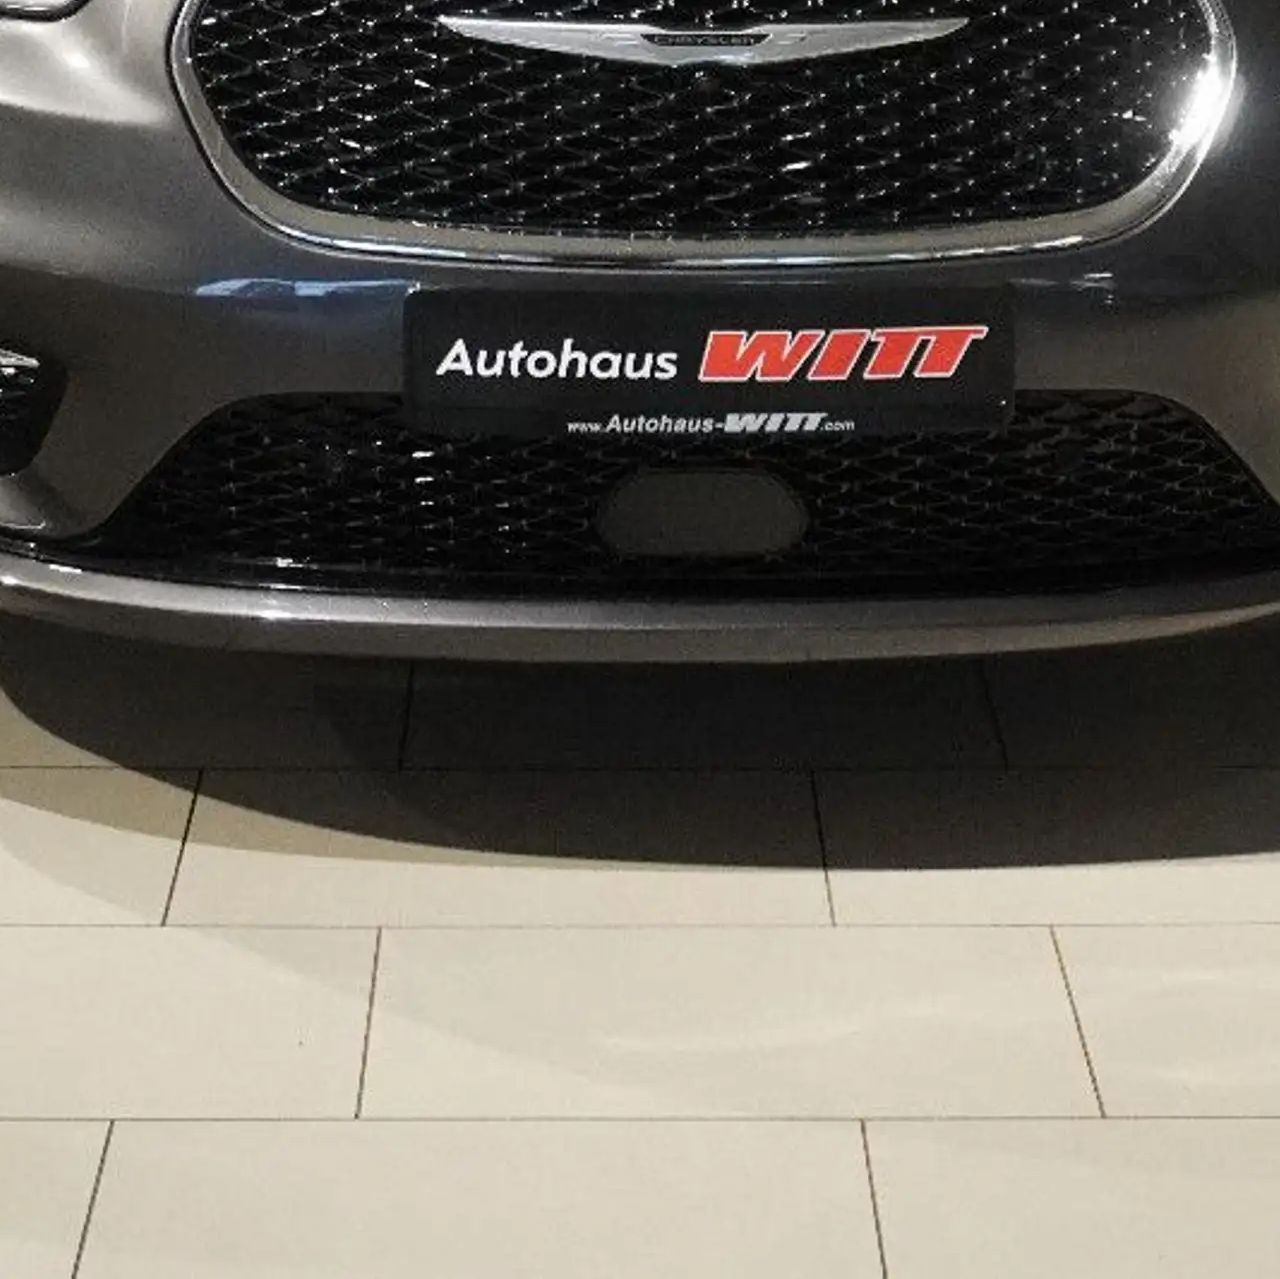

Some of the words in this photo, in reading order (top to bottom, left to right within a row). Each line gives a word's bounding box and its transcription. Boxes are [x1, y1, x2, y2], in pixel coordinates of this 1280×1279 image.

[436, 337, 678, 380] Autohaus
[697, 326, 988, 382] WITT
[567, 412, 855, 433] www.Autohaus-WITT.com
